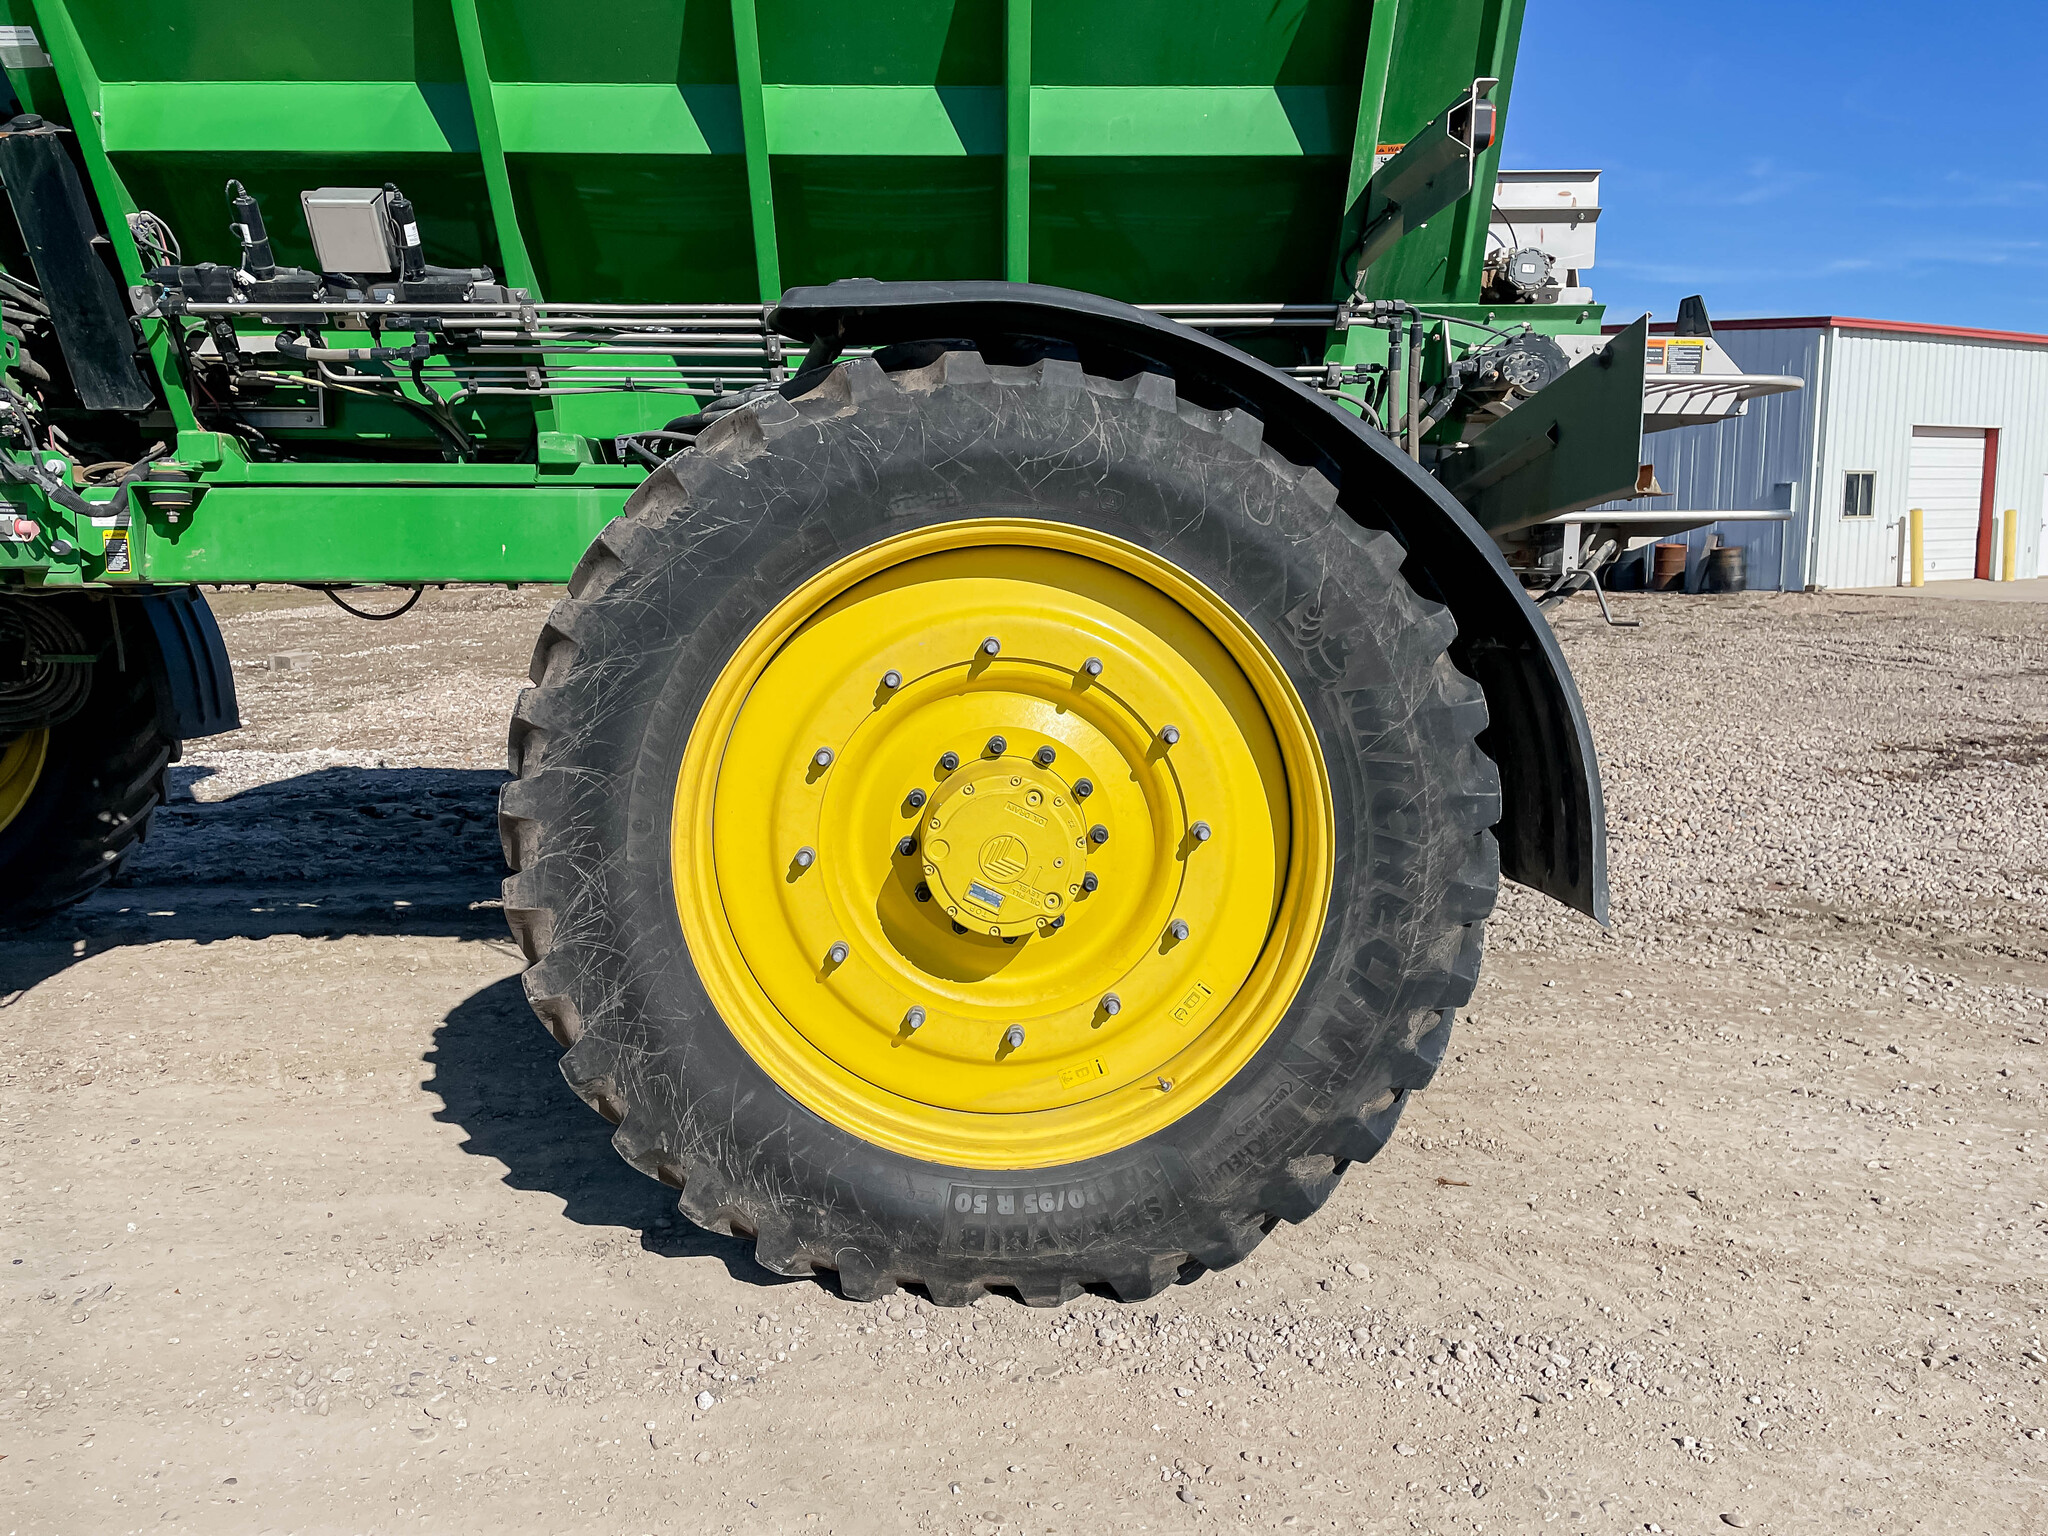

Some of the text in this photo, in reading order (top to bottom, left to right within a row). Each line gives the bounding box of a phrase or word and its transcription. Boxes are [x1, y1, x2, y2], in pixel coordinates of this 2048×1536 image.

[1006, 804, 1045, 825] OIL DRAIN
[1018, 884, 1040, 898] LEVEL
[969, 905, 986, 918] TOP
[955, 1192, 990, 1214] 50
[997, 1195, 1016, 1214] R
